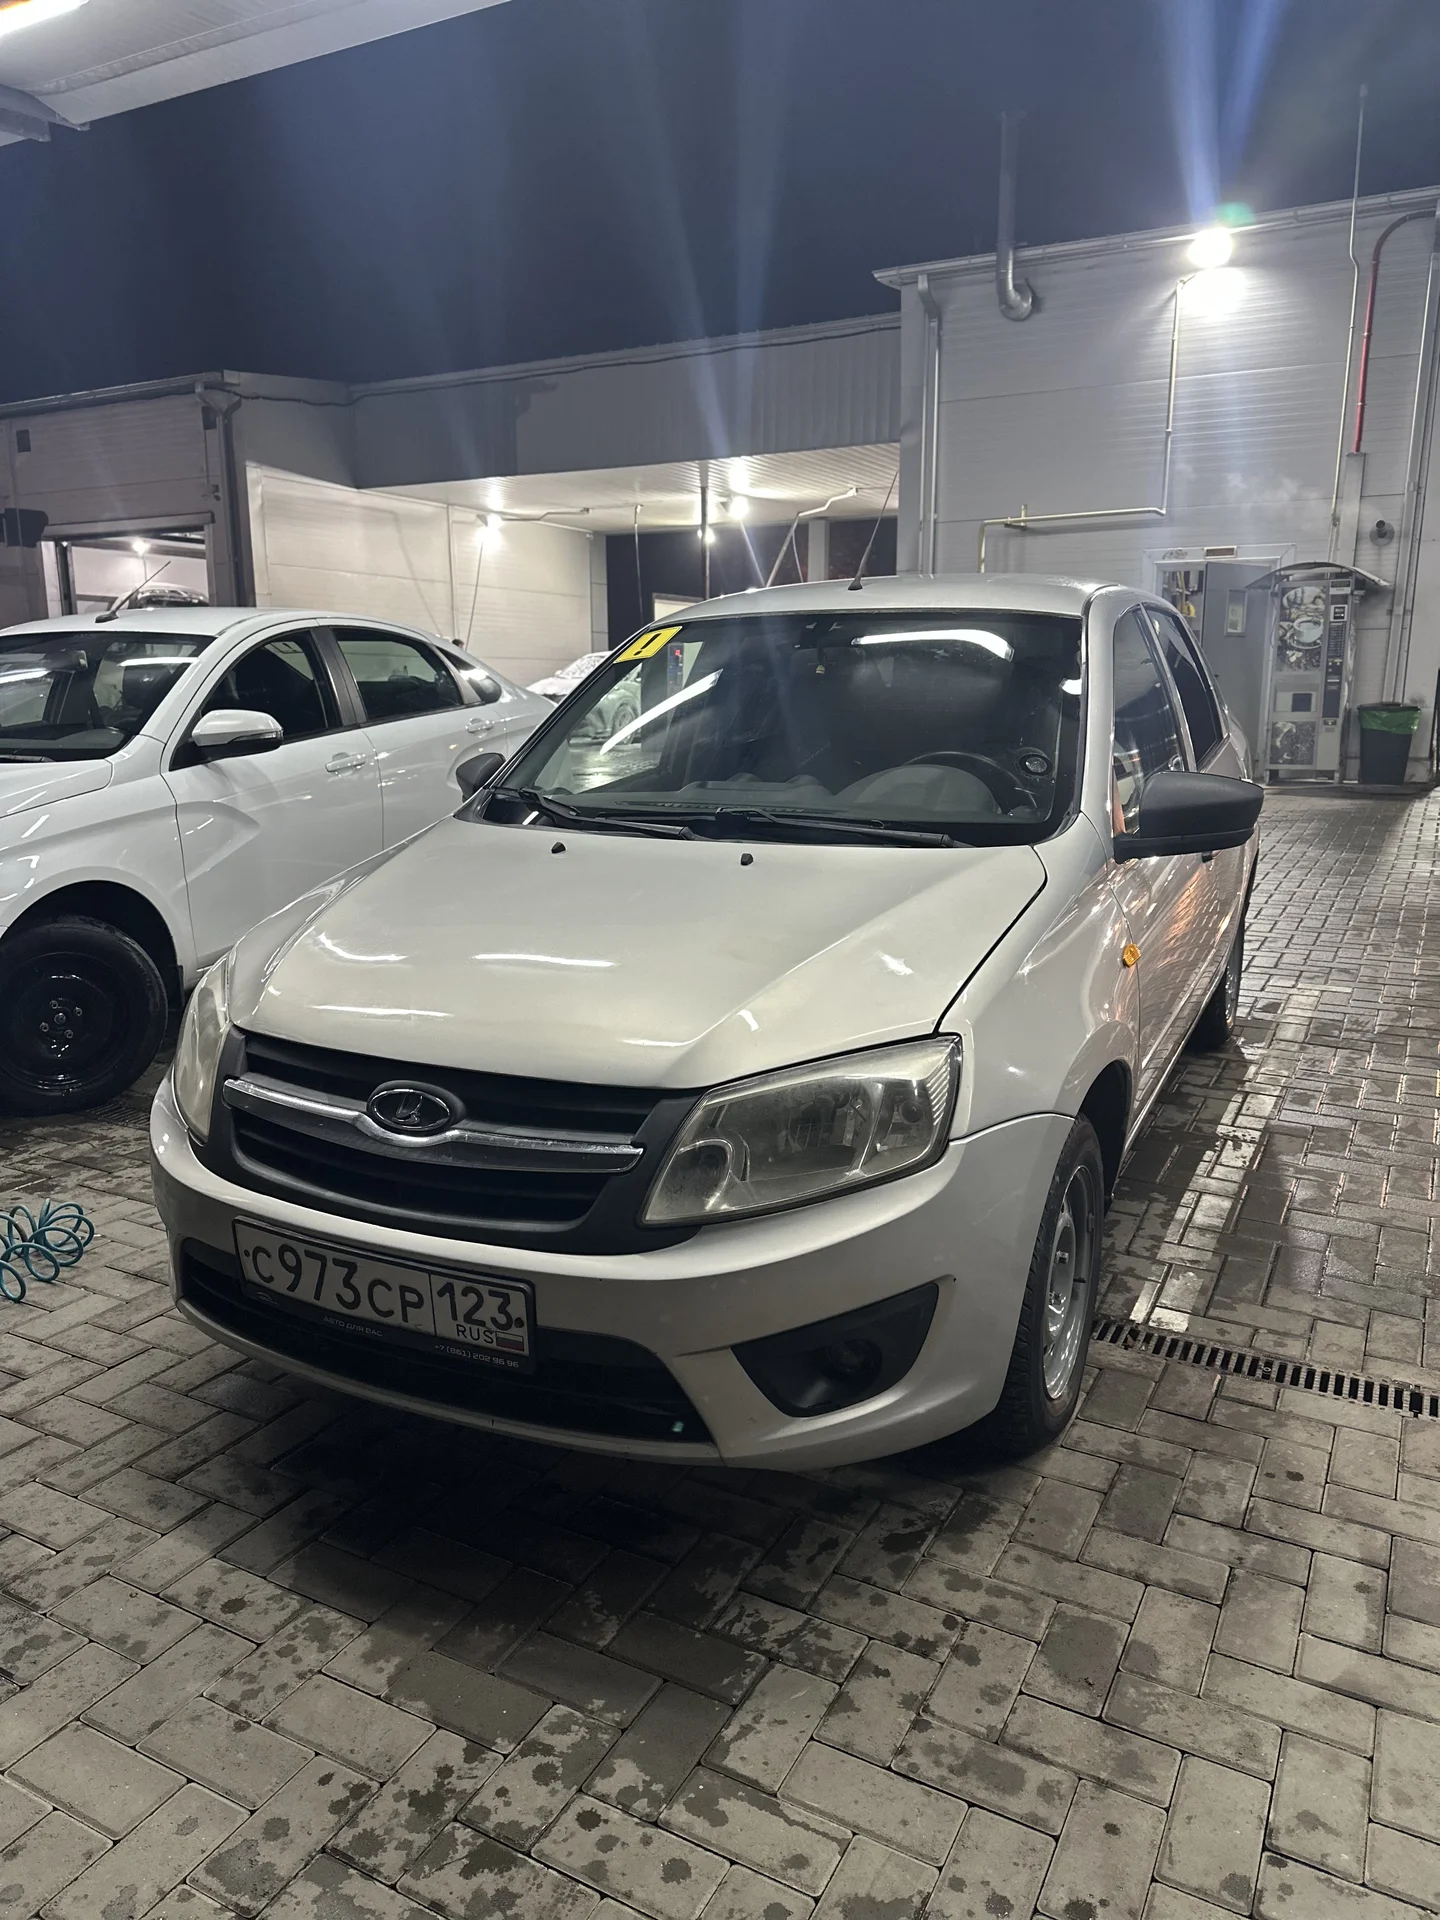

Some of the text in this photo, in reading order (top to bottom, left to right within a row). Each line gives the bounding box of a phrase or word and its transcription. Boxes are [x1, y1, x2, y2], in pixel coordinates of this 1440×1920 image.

[251, 1243, 424, 1323] С973СР
[436, 1281, 513, 1331] 123
[365, 1327, 383, 1337] ВАС
[456, 1324, 494, 1345] RUS
[472, 1352, 491, 1363] 202
[492, 1357, 505, 1366] 96
[506, 1360, 520, 1368] 96
